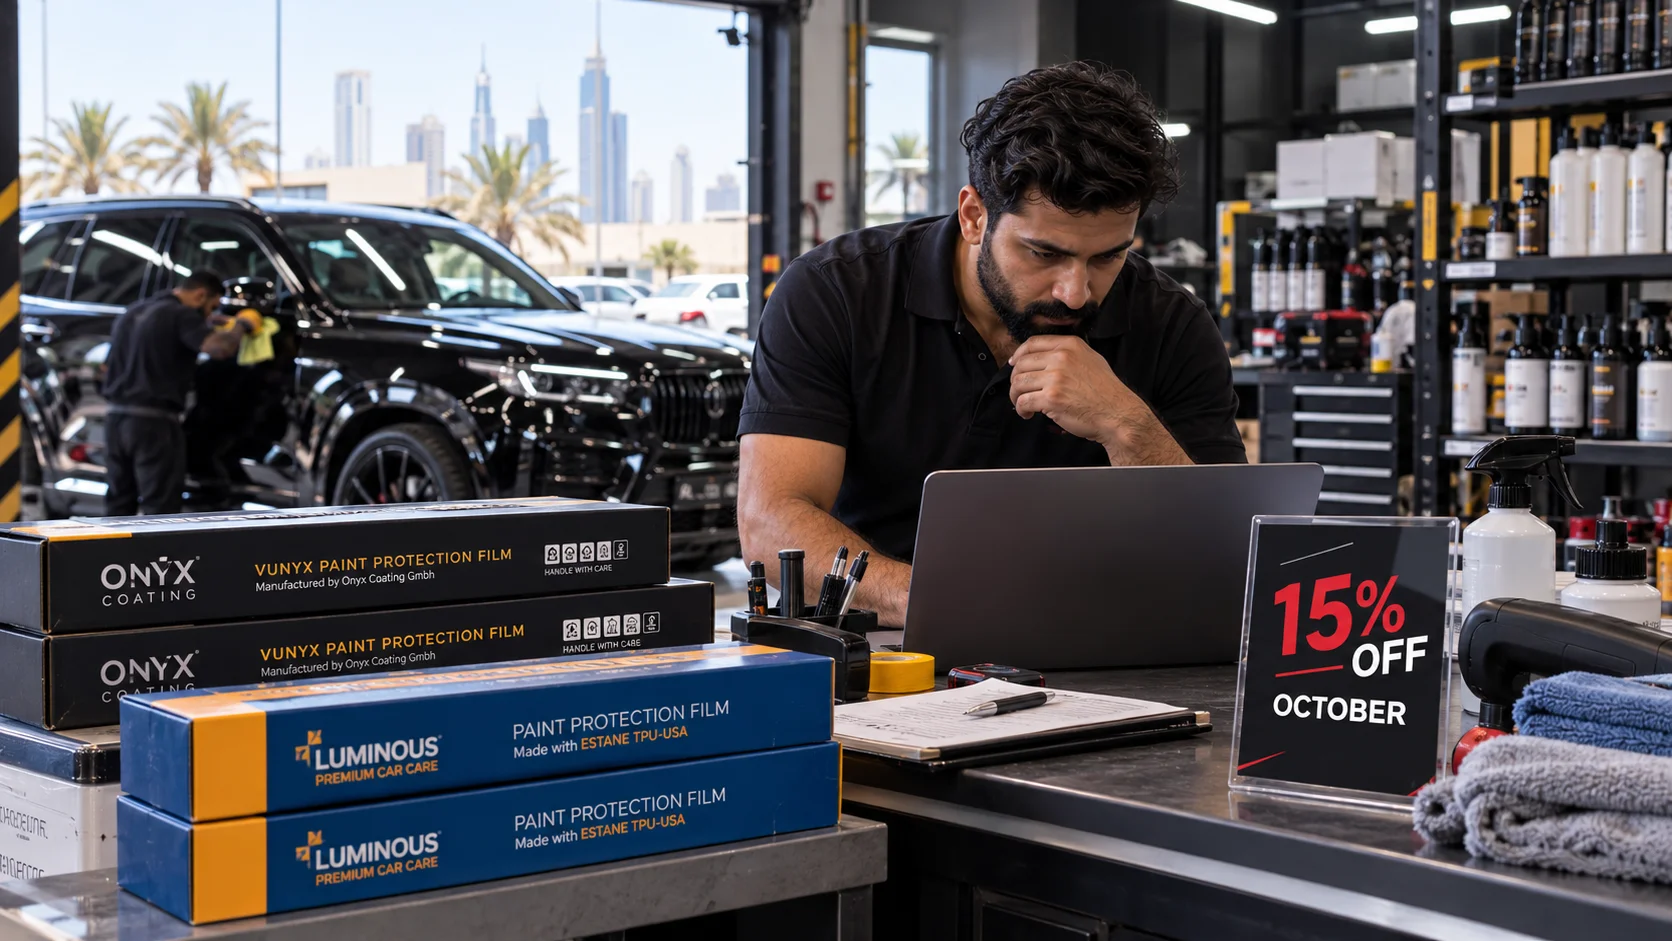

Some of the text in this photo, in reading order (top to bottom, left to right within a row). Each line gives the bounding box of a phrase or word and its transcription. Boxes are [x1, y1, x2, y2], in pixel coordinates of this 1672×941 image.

[101, 556, 196, 590] ONYX
[255, 548, 512, 576] VUNYX PAINT PROTECTION FILM
[575, 565, 593, 574] WITH
[594, 564, 613, 572] CARE
[102, 588, 196, 607] COATING
[255, 570, 435, 592] Manufactured by Onyx Coating Gmbh
[1273, 572, 1406, 656] 15%
[260, 624, 524, 661] VUNYX PAINT PROTECTION FILM
[597, 641, 619, 650] WITH
[1352, 635, 1429, 678] OFF
[100, 653, 195, 686] ONYX
[261, 651, 436, 677] Manufactured by Onyx Coating Gmbh
[513, 700, 729, 740] PAINT PROTECTION FILM
[1273, 693, 1407, 726] OCTOBER
[315, 736, 439, 770] LUMINOUS
[513, 725, 689, 758] Made with ESTANE TPU-USA
[315, 759, 439, 786] PREMIUM CAR CARE
[514, 787, 726, 831] PAINT PROTECTION FILM
[514, 813, 686, 849] Made with ESTANE TPU-USA
[315, 832, 439, 870] LUMINOUS
[315, 856, 439, 886] PREMIUM CAR CARE
